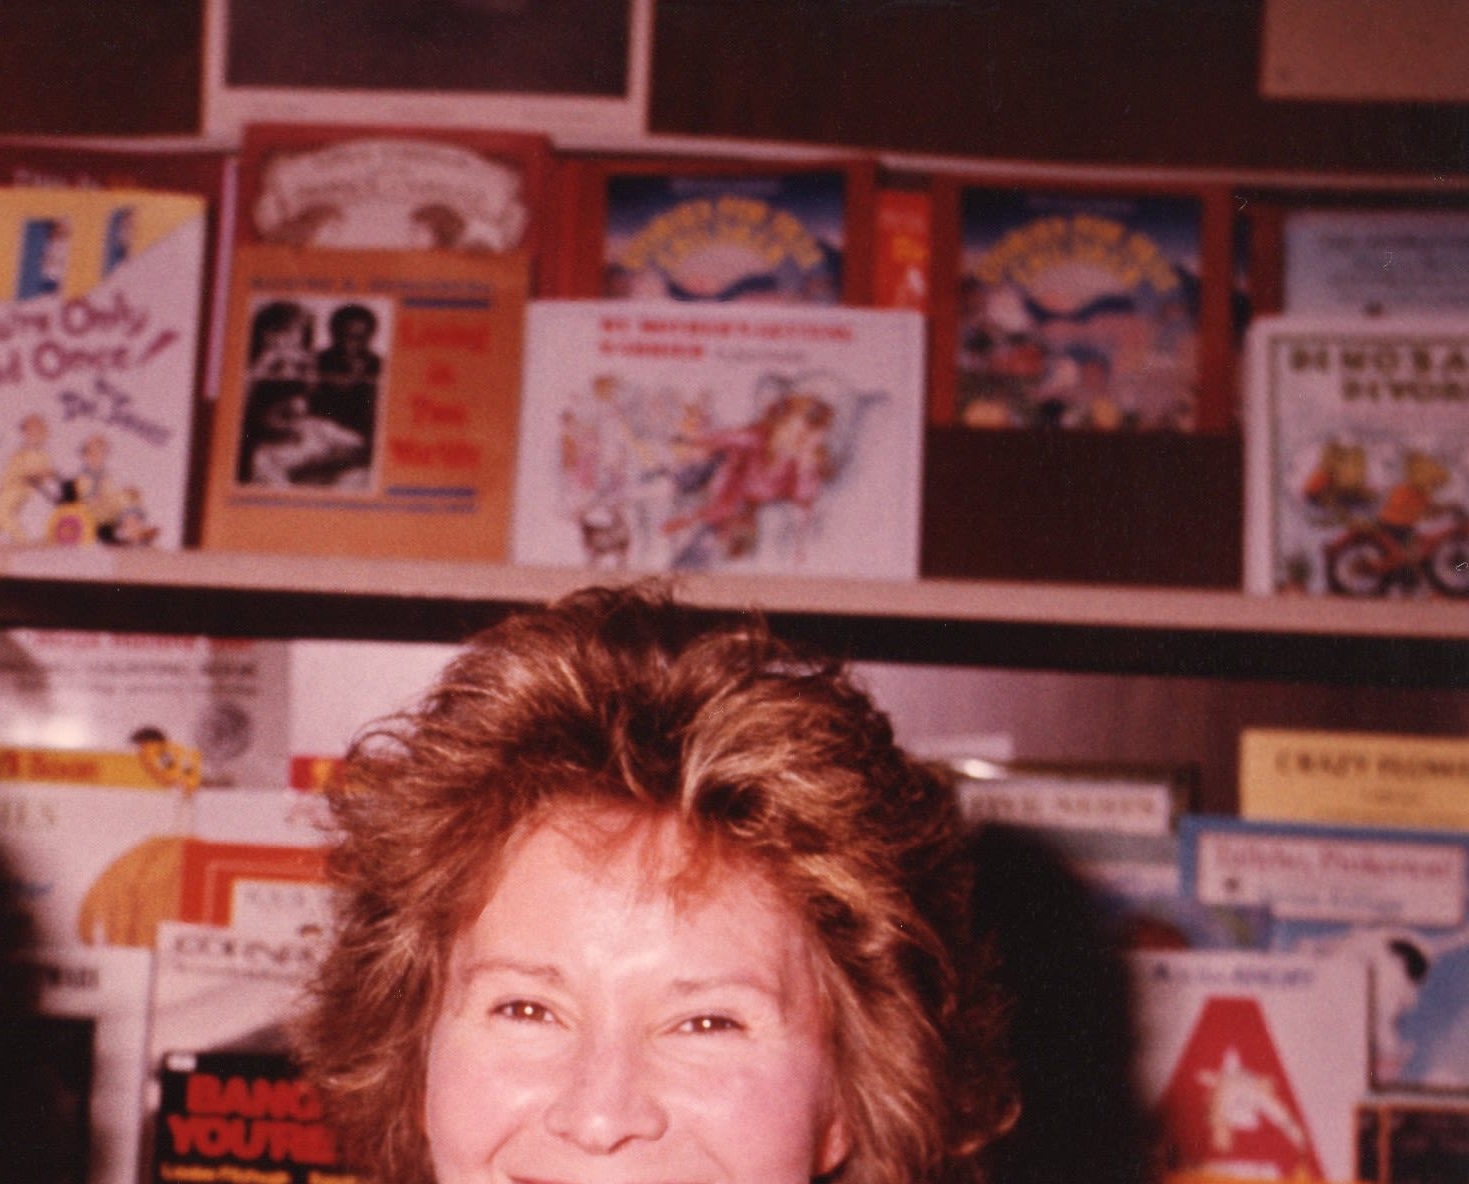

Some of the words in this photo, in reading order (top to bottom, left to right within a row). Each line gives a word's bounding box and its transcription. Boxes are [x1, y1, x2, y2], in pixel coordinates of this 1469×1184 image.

[62, 291, 149, 337] Only
[1290, 346, 1469, 376] DINOSA
[1341, 381, 1469, 403] DIVOR
[186, 1073, 322, 1120] BANG
[168, 1116, 337, 1165] YOU'RE
